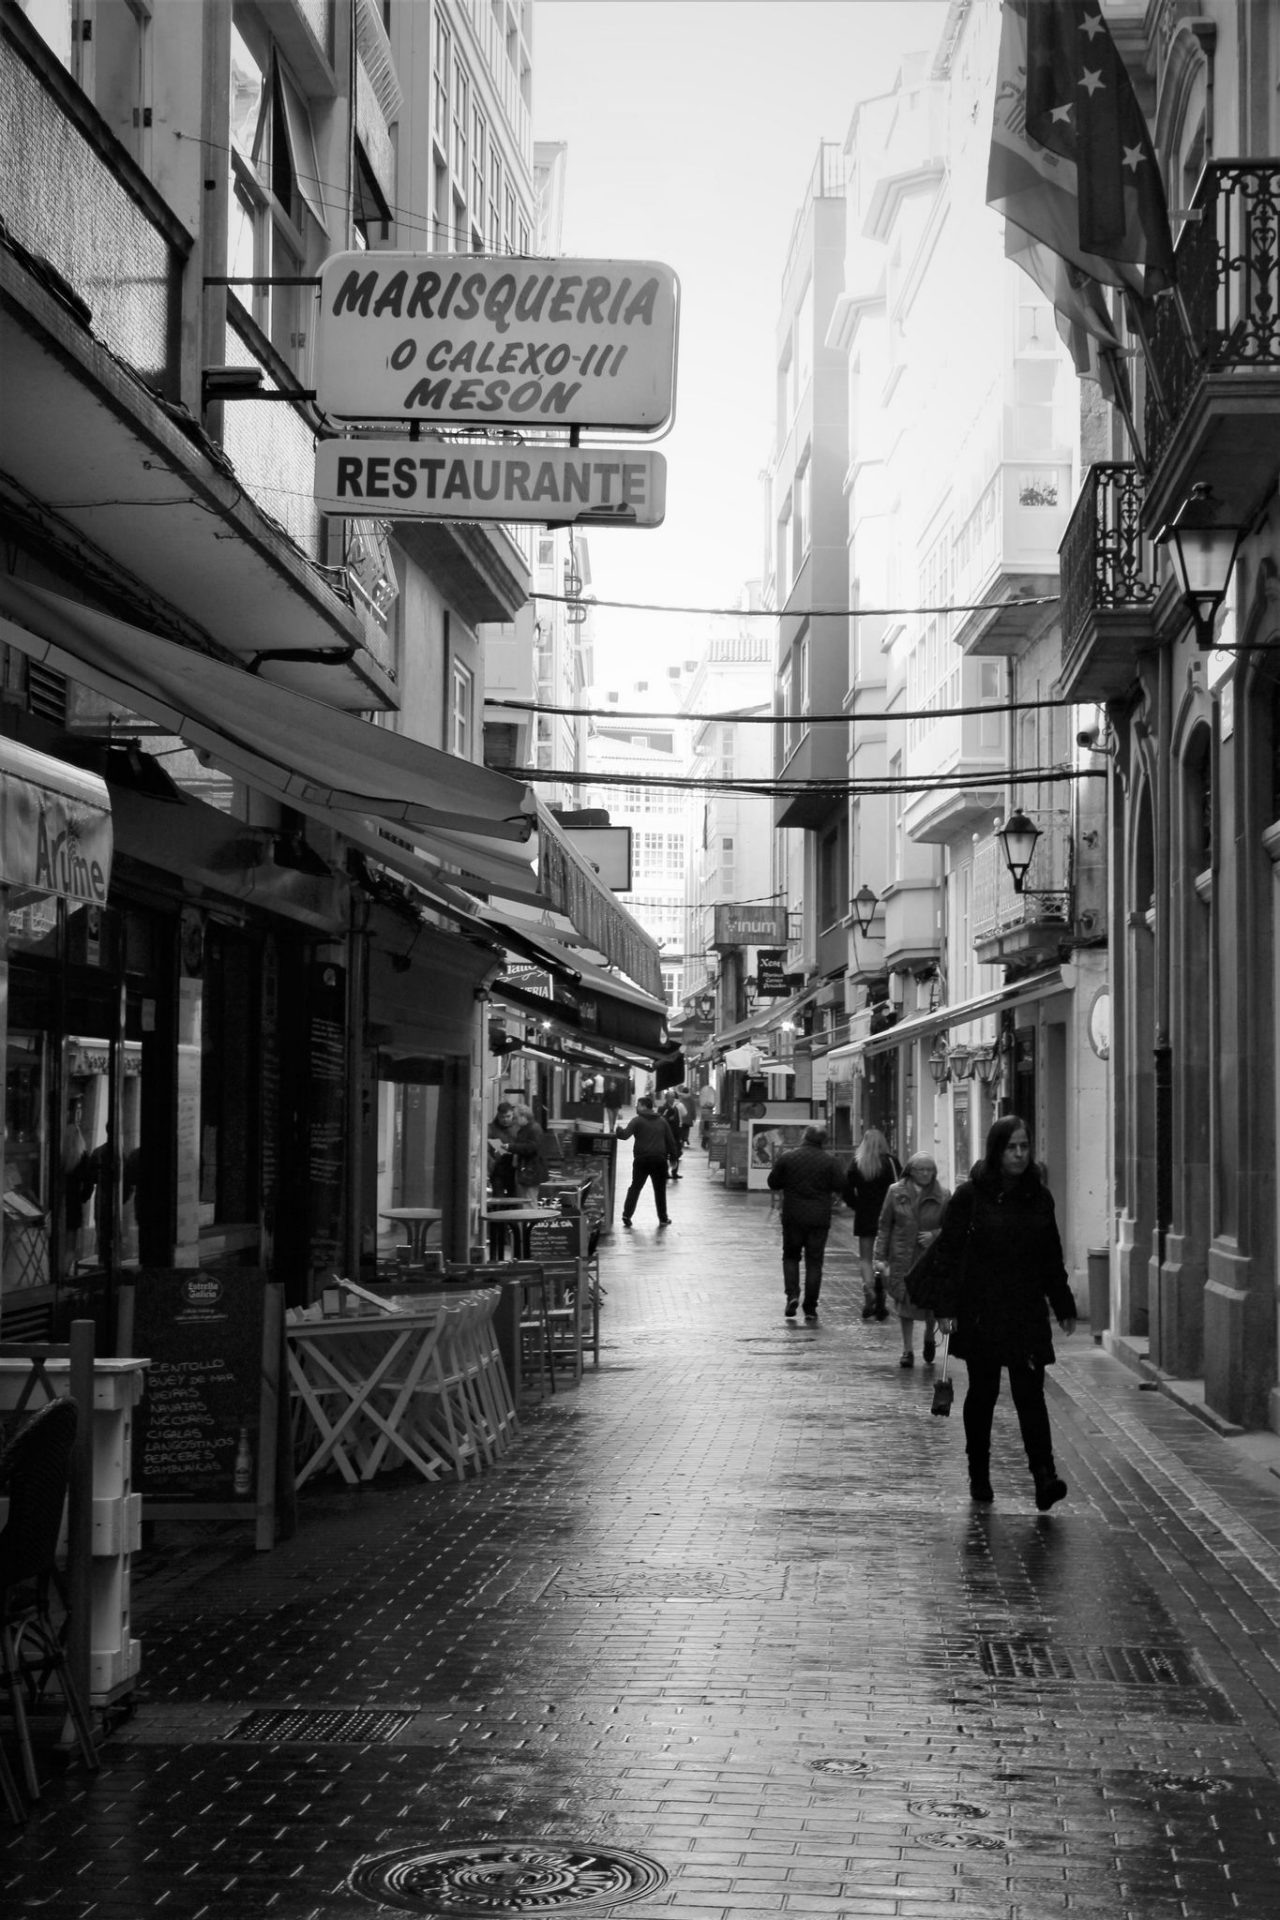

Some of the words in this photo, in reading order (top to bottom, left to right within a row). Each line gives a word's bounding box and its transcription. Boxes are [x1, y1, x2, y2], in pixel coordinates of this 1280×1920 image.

[331, 269, 661, 334] MARISQUERIA
[390, 338, 417, 371] O
[426, 340, 629, 377] CALEXO-III
[403, 374, 583, 415] MESÓN
[336, 456, 647, 505] RESTAURANTE
[36, 806, 105, 900] Arume
[187, 1281, 219, 1290] Estrella
[148, 1374, 186, 1387] BUEY
